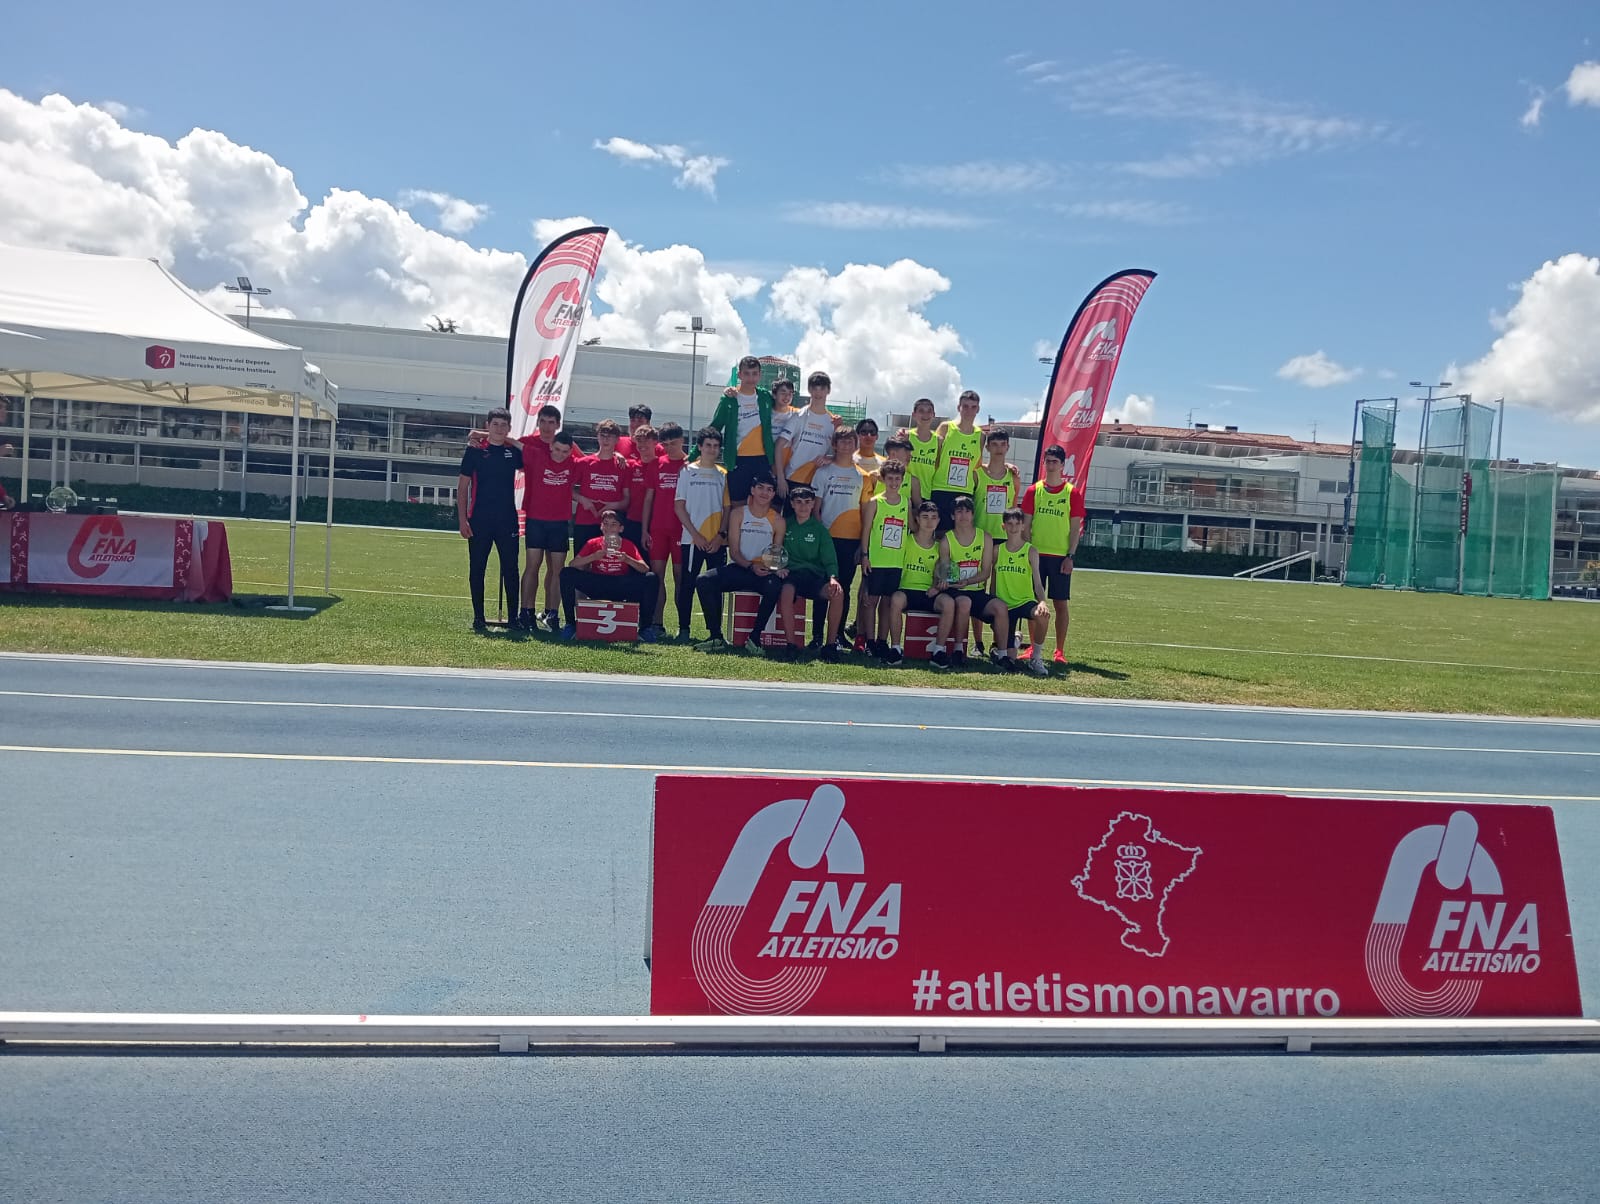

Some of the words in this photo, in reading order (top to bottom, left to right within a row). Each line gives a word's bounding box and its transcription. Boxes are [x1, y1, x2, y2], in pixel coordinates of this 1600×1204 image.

[1091, 341, 1120, 357] FNA
[1070, 409, 1097, 424] FNA
[949, 465, 964, 482] 26
[988, 493, 1002, 507] 26
[884, 527, 900, 542] 26
[92, 538, 136, 555] FNA
[88, 554, 135, 563] ATLETISMO
[596, 609, 617, 634] 3
[768, 880, 902, 935] FNA
[1429, 900, 1540, 951] FNA
[757, 936, 899, 960] ATLETISMO
[1422, 951, 1541, 974] ATLETISMO
[912, 969, 1341, 1018] #atletismonavarro
